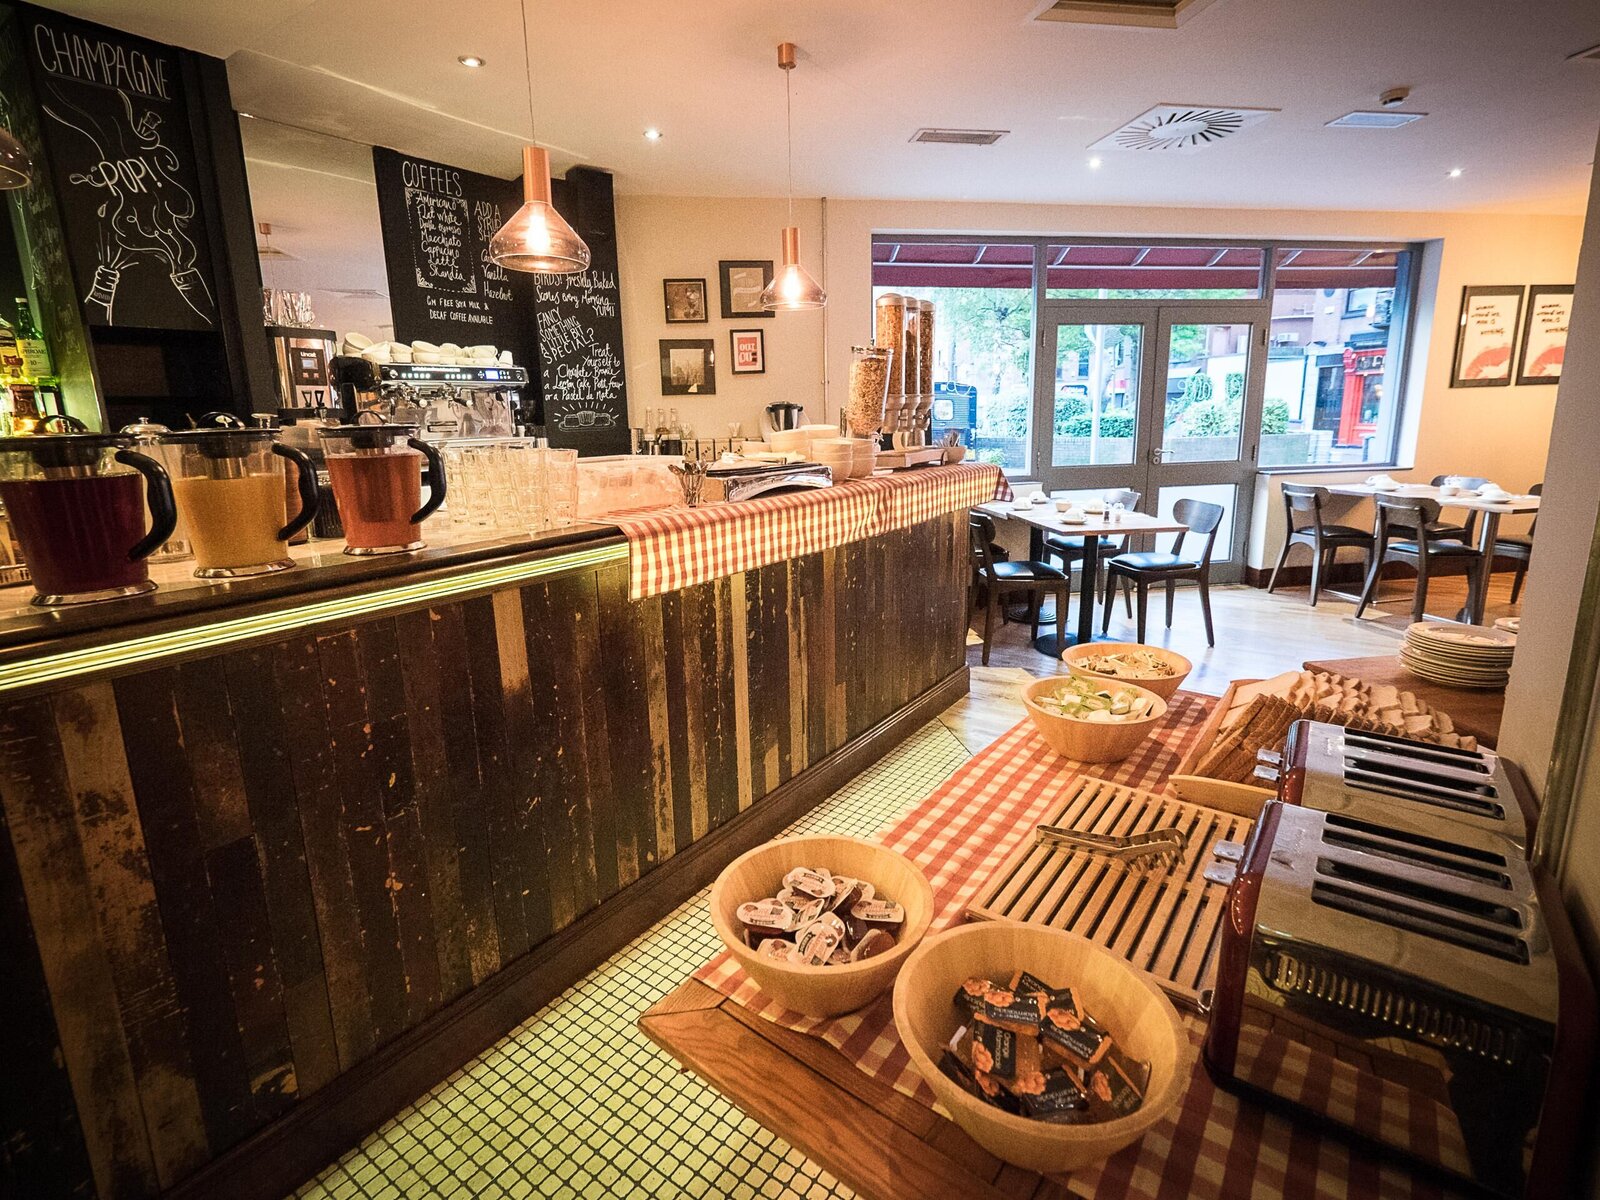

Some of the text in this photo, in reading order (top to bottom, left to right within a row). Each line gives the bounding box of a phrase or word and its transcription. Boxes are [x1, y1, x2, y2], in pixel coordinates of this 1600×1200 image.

[34, 23, 171, 100] CHAMPAGNE
[98, 155, 163, 196] POP!
[402, 161, 462, 197] COFFEES
[416, 191, 457, 211] Americano
[474, 201, 502, 219] ADD A
[417, 204, 436, 219] Flat
[428, 253, 459, 268] Latte
[481, 264, 509, 281] Vanilla
[592, 270, 616, 290] Baked
[483, 281, 513, 301] Hazelnut
[440, 298, 454, 308] FREE
[429, 309, 448, 321] DECAF
[449, 311, 467, 323] COFFEE
[536, 306, 562, 329] FANCY
[540, 315, 581, 343] SOMETHING
[540, 324, 584, 354] A LITTLE BIT
[543, 327, 595, 365] SPECIAL?
[588, 342, 613, 357] Treat
